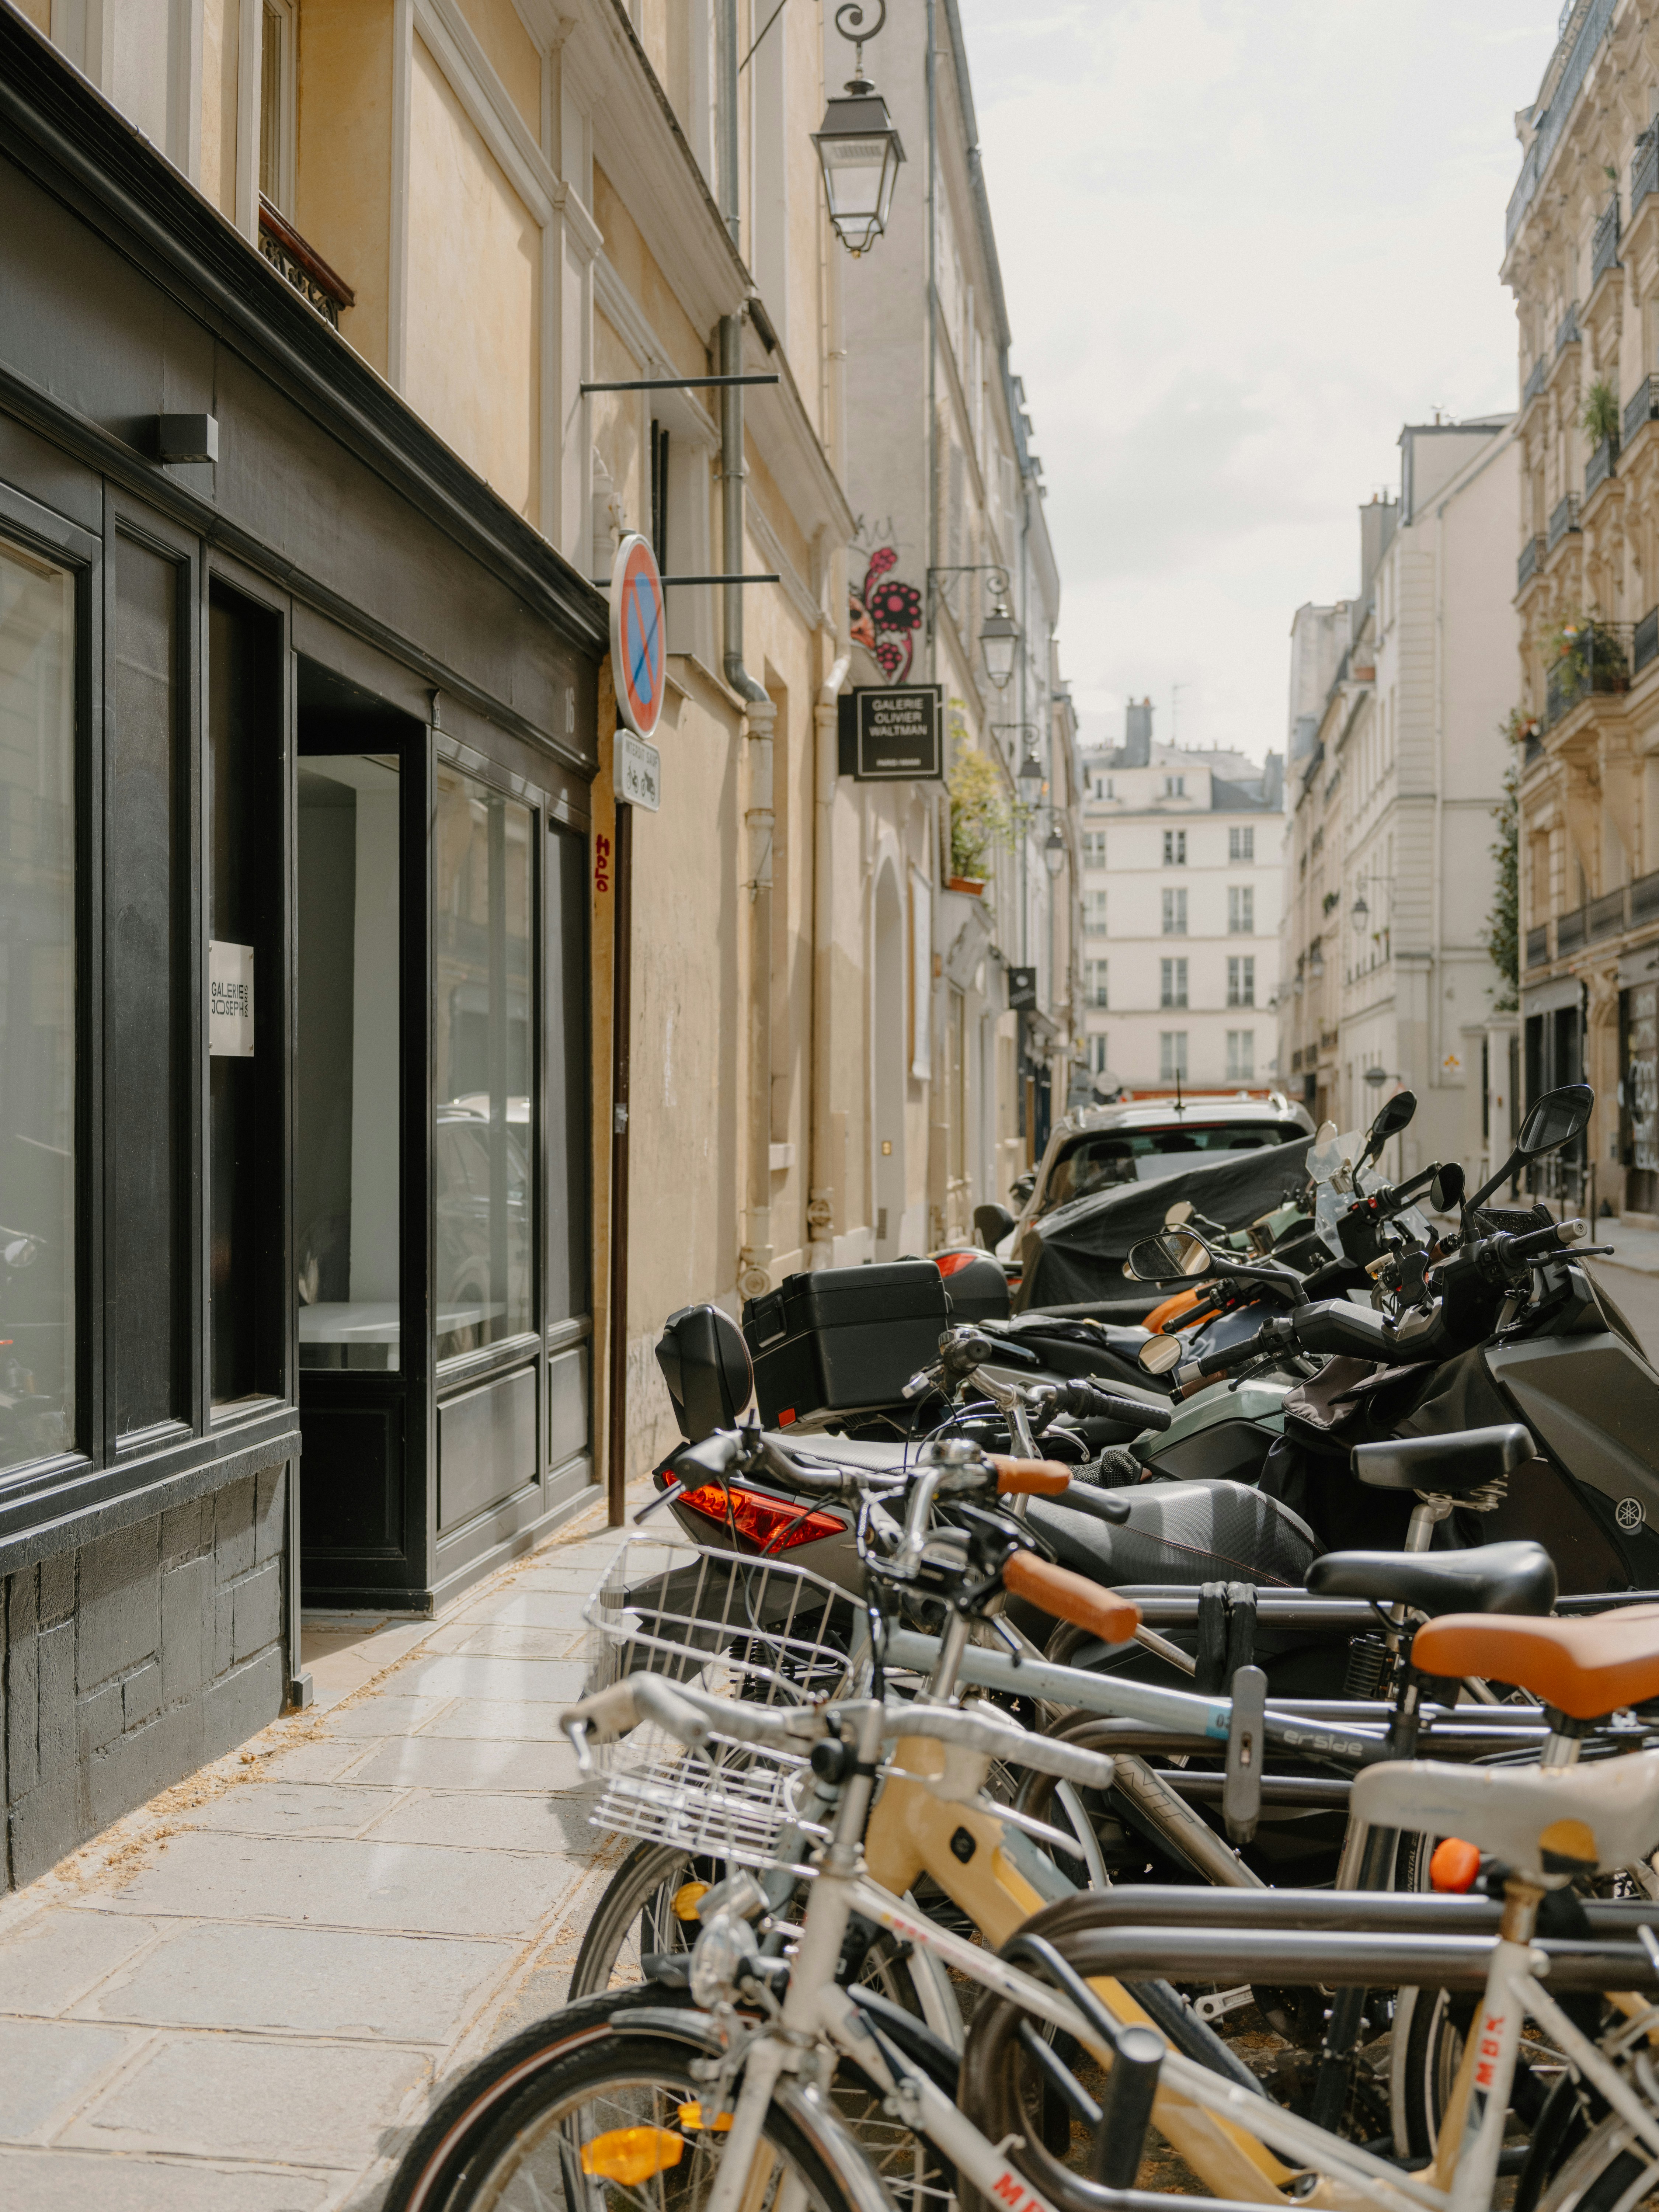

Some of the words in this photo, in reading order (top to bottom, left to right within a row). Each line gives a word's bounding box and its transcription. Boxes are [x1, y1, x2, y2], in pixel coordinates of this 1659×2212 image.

[872, 698, 924, 711] GALERIE
[874, 711, 922, 724] OLIVIER
[869, 724, 927, 737] WALTMAN
[626, 739, 644, 761] INTERDIT
[646, 752, 657, 767] SAUF
[212, 982, 244, 999] GALERIE
[212, 999, 244, 1017] JOSEPH
